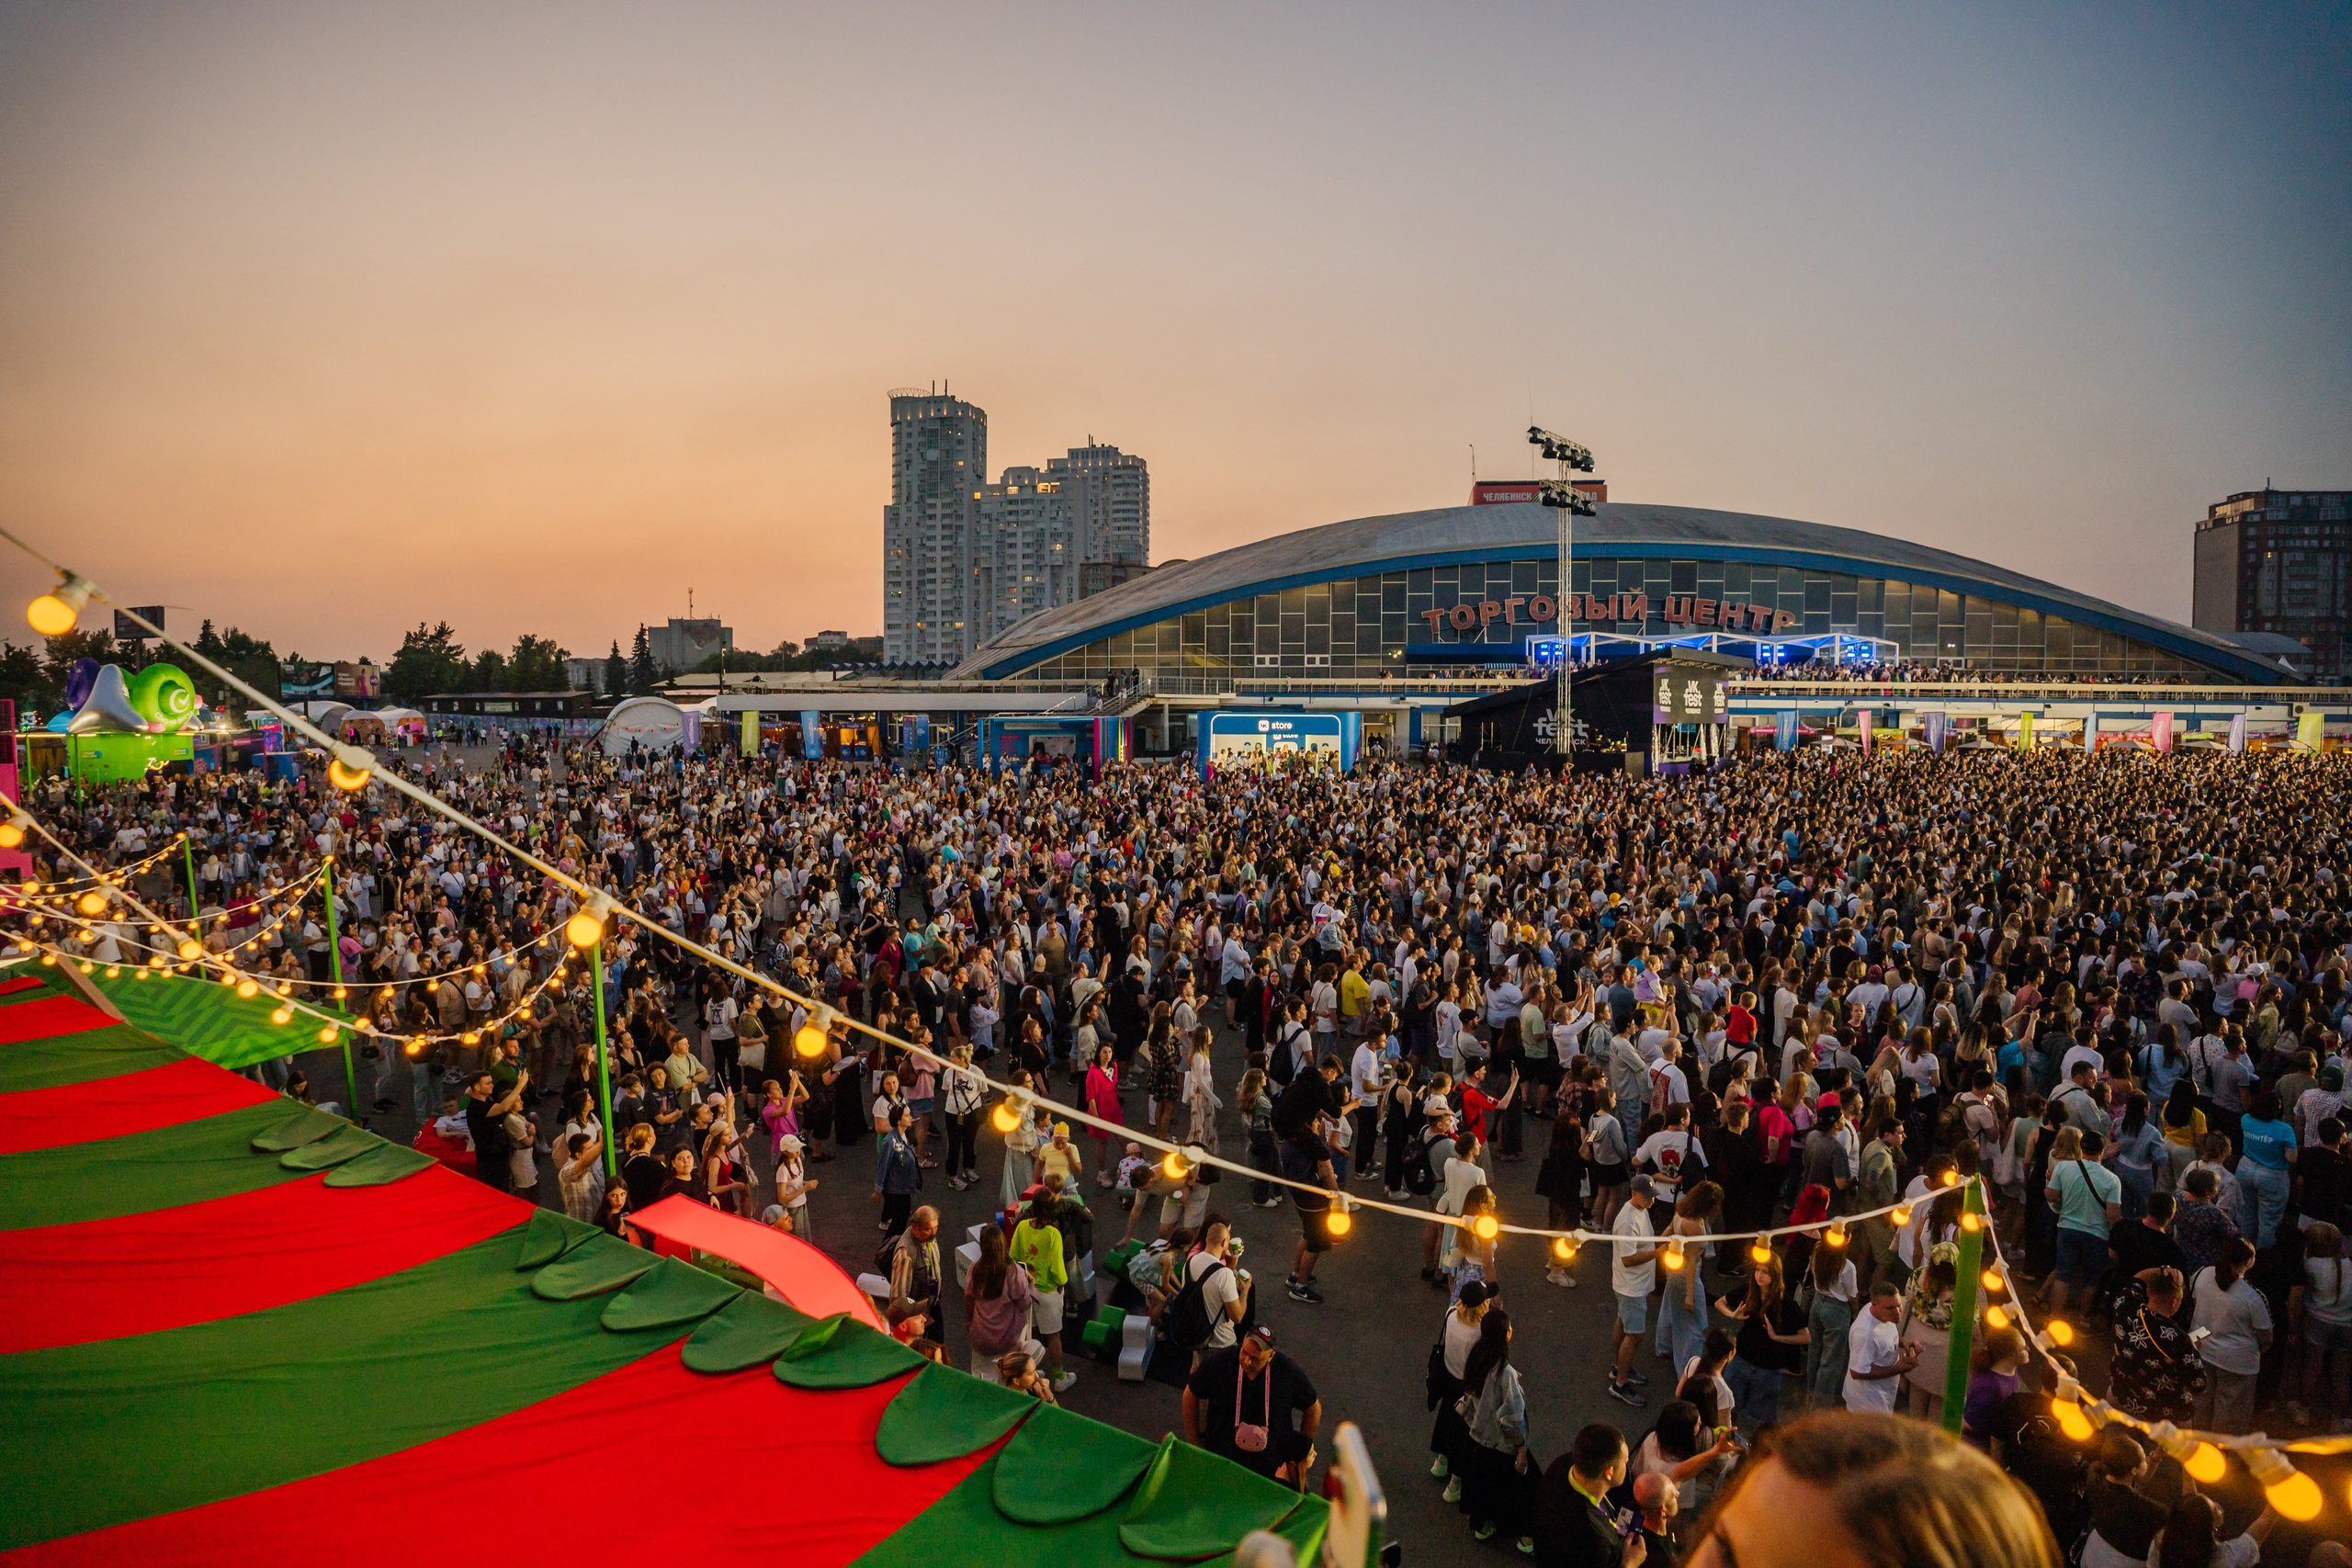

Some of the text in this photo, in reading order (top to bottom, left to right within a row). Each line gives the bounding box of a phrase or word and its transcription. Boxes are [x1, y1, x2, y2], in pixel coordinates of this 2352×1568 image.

[1483, 491, 1532, 502] ЧЕЛЯБИНСК
[1421, 586, 1796, 636] ТОРГОВЫЙ ЦЕНТР
[1661, 678, 1669, 692] VK
[1688, 680, 1699, 694] VK
[1715, 682, 1724, 695] VK
[1658, 686, 1672, 705] fest
[1683, 688, 1702, 707] fest
[1713, 690, 1725, 707] fest
[1271, 721, 1293, 729] store
[1532, 716, 1589, 737] fest
